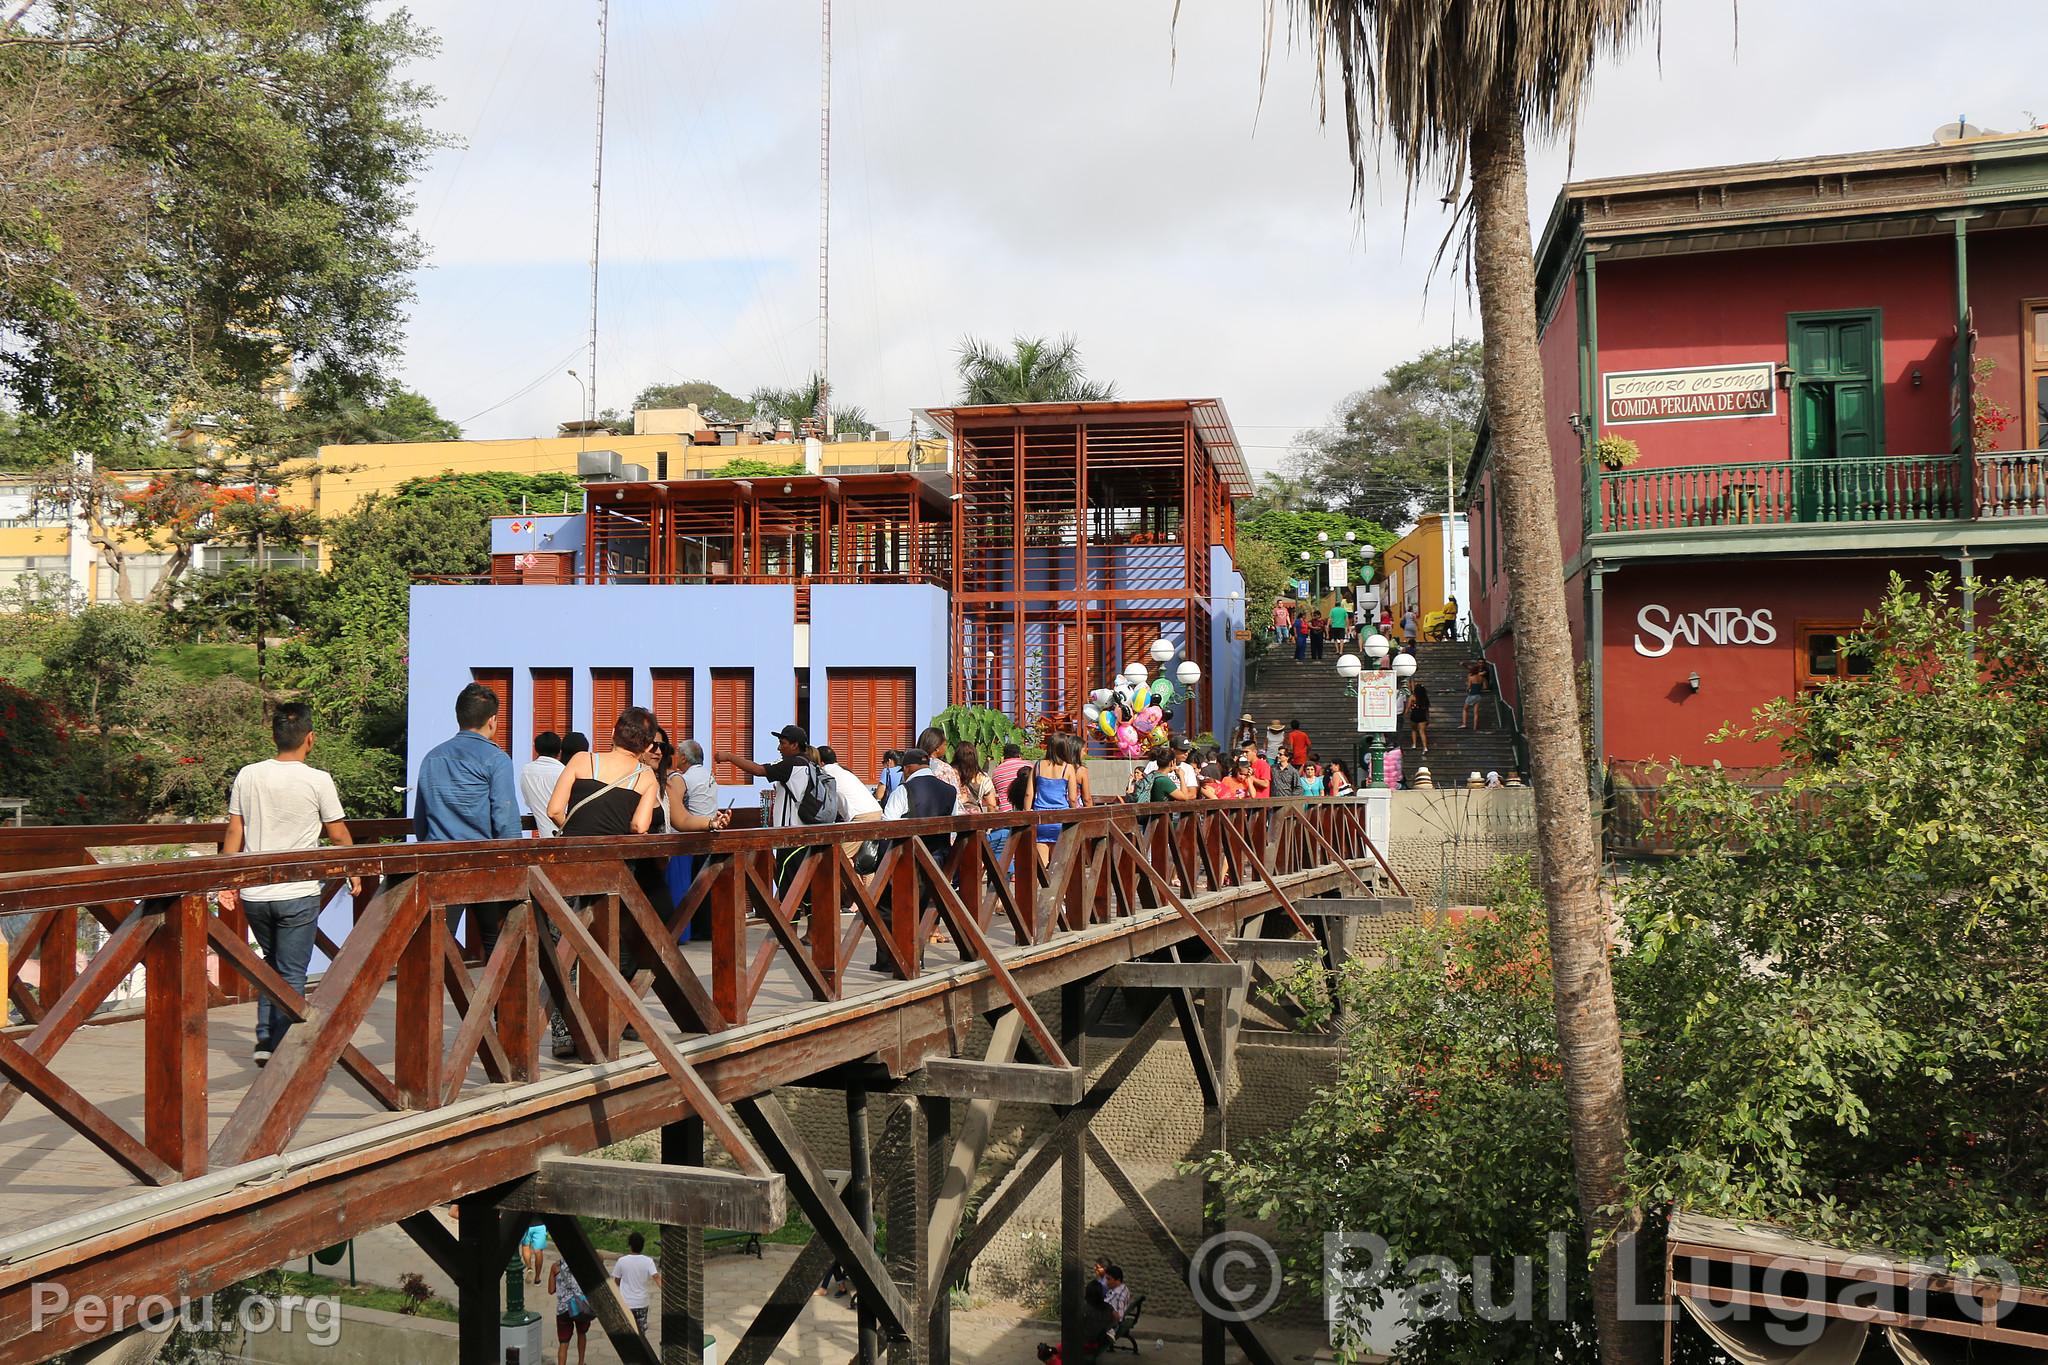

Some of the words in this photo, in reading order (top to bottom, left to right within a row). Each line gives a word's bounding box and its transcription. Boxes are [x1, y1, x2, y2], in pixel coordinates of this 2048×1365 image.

[1614, 378, 1686, 396] SÓNGORO
[1692, 374, 1765, 391] COSONGO
[1611, 398, 1659, 417] COMIDA
[1660, 395, 1716, 414] PERUANA
[1718, 393, 1734, 411] DE
[1736, 391, 1768, 410] CASA
[1634, 604, 1777, 657] SANTOS
